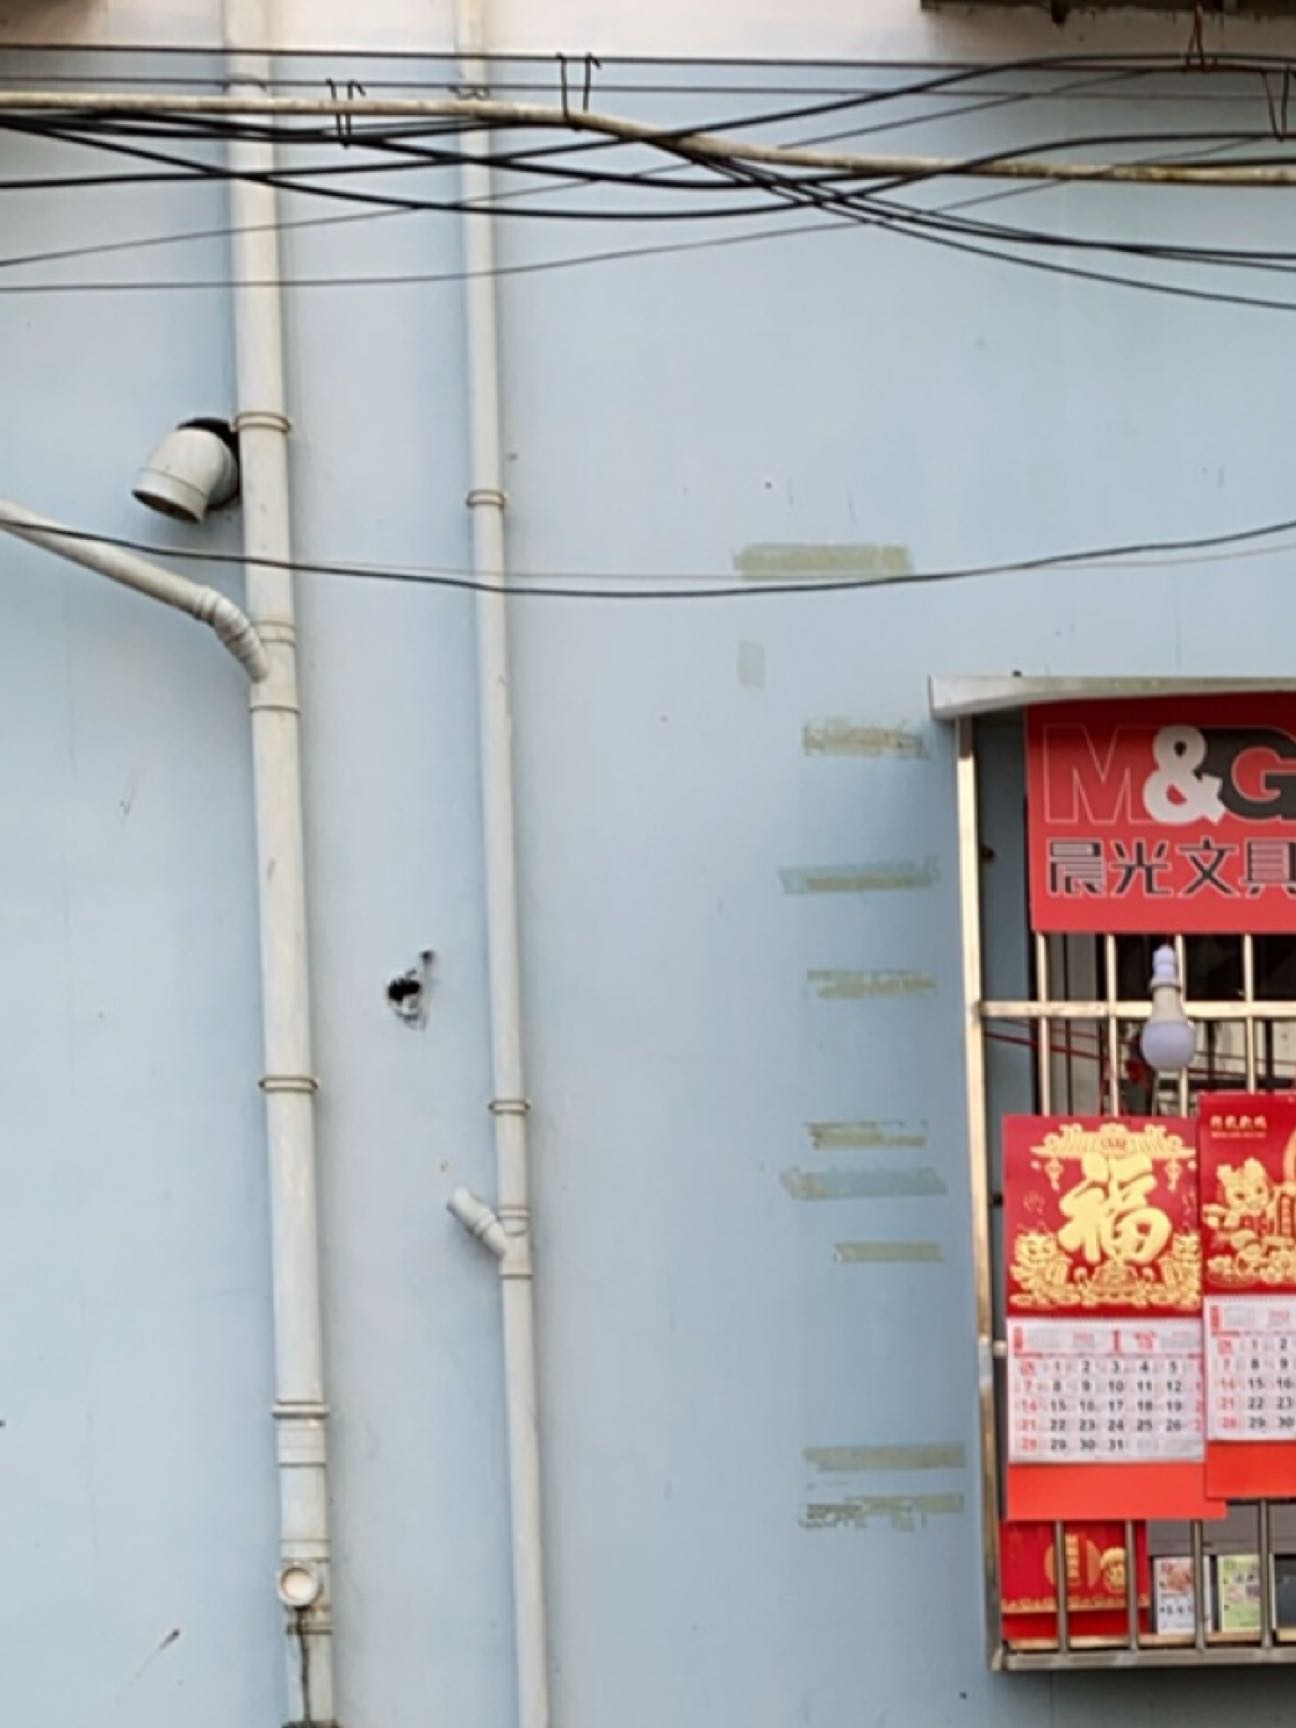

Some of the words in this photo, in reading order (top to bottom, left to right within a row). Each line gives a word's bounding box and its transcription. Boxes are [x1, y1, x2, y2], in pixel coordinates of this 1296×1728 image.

[1057, 1153, 1173, 1264] 福
[1248, 1376, 1264, 1391] 15
[1276, 1376, 1292, 1390] 16
[1050, 1398, 1067, 1412] 15
[1079, 1398, 1097, 1412] 16
[1108, 1398, 1125, 1412] 17
[1136, 1398, 1153, 1412] 18
[1165, 1398, 1183, 1412] 19
[1248, 1395, 1264, 1411] 22
[1276, 1395, 1293, 1410] 23
[1050, 1418, 1067, 1432] 22
[1079, 1418, 1097, 1432] 23
[1108, 1418, 1124, 1432] 24
[1136, 1418, 1153, 1432] 25
[1165, 1418, 1182, 1432] 26
[1248, 1415, 1266, 1430] 29
[1278, 1415, 1296, 1429] 30
[1050, 1438, 1067, 1452] 29
[1079, 1438, 1097, 1452] 30
[1108, 1438, 1124, 1452] 31
